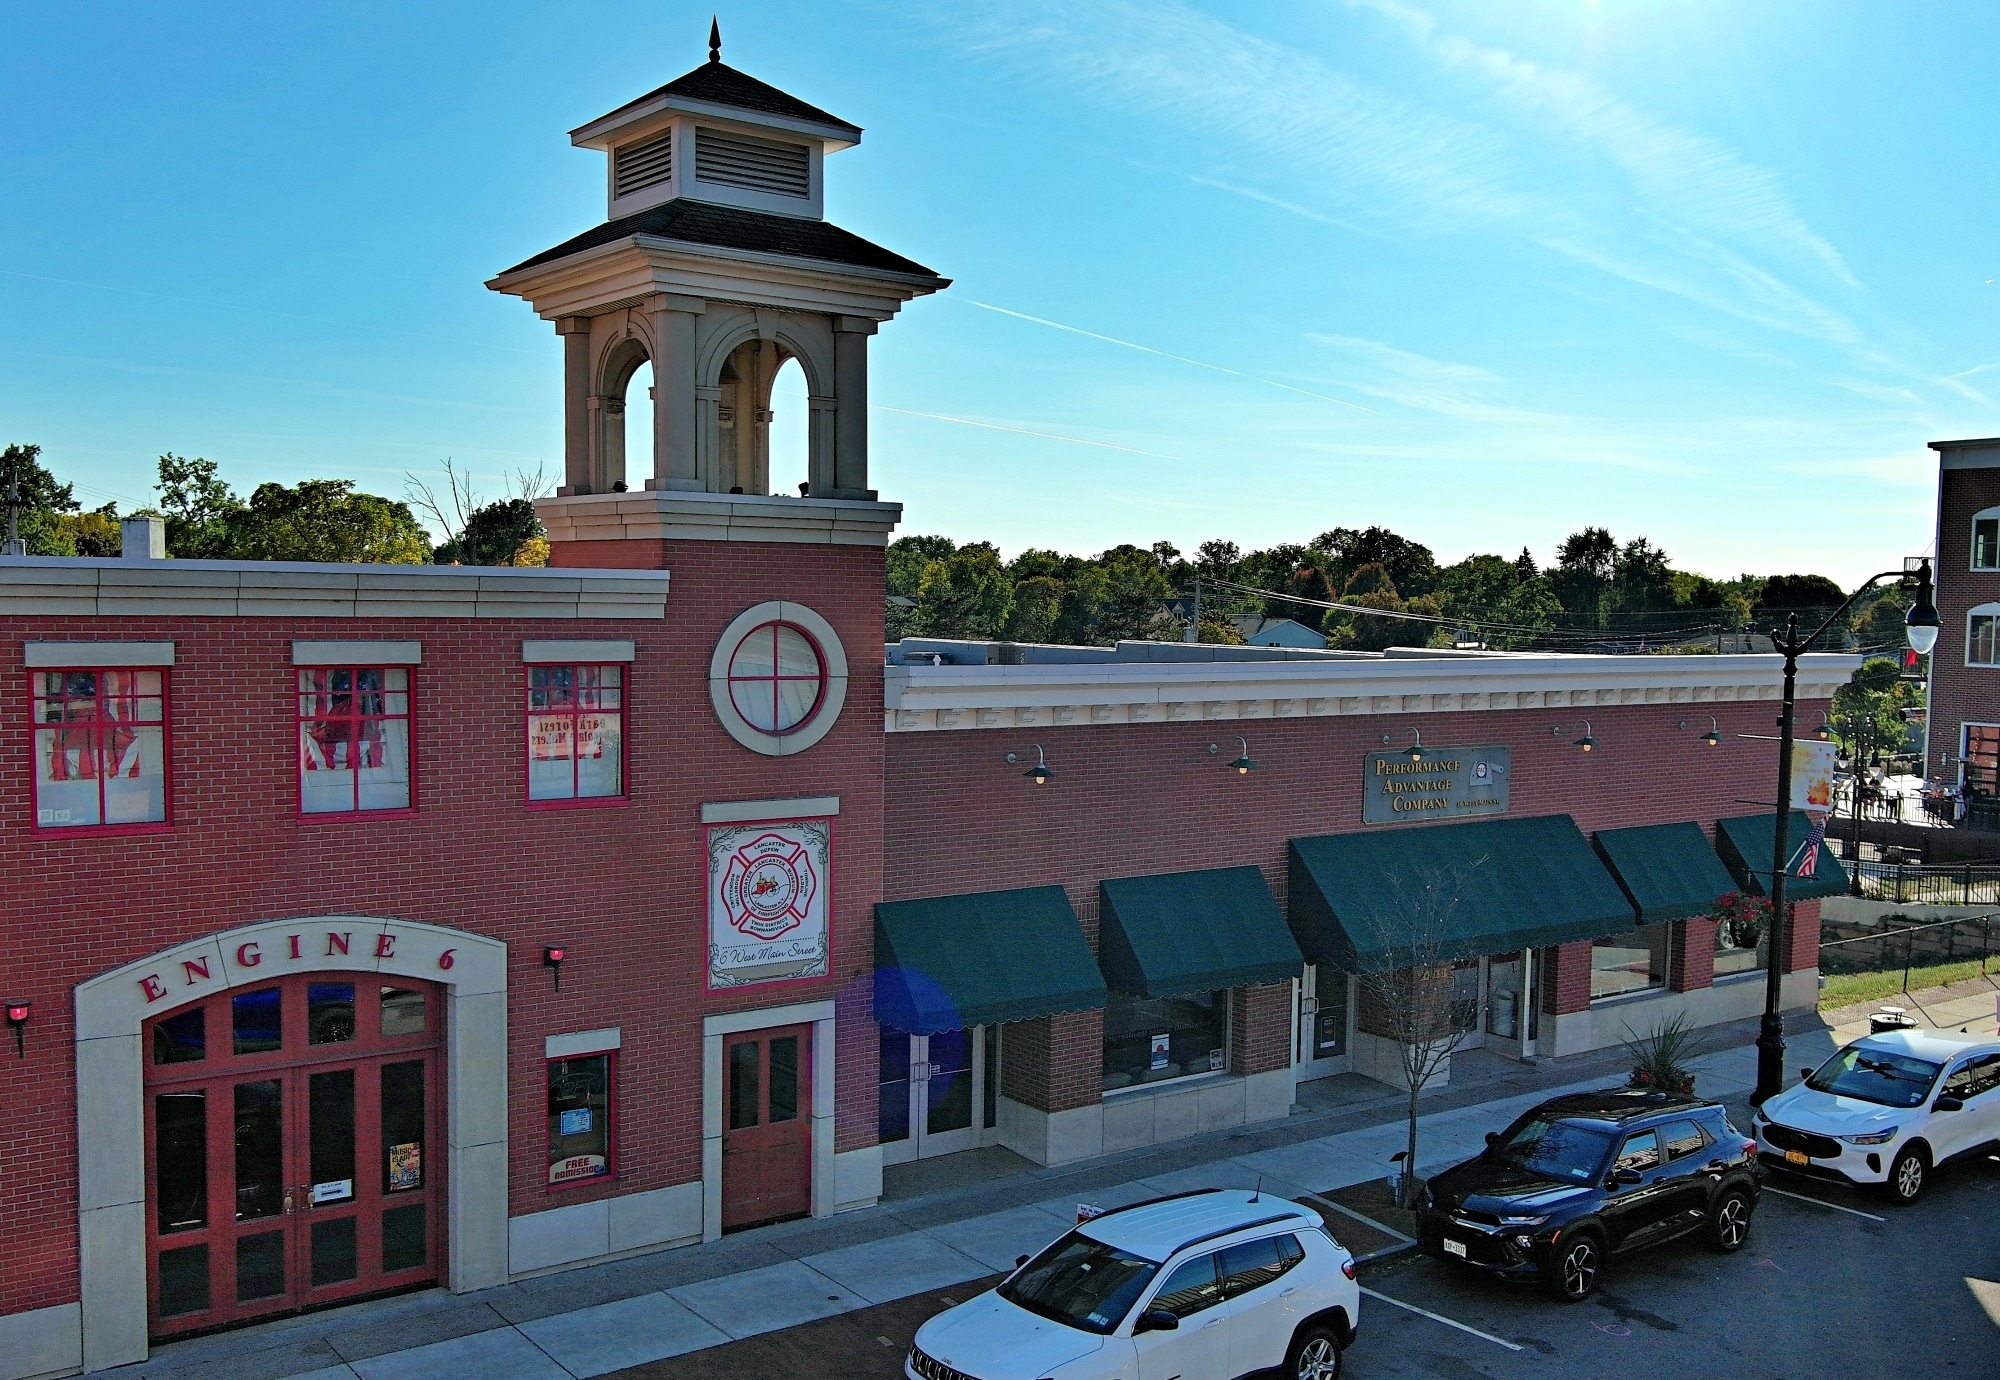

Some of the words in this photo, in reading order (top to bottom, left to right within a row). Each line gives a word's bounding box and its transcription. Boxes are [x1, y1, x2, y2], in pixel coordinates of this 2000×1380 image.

[1375, 759, 1461, 776] PERFORMANCE
[1381, 777, 1452, 794] ADVANTAGE
[1392, 795, 1449, 812] COMPANY
[753, 841, 786, 850] LANCASTER
[743, 870, 753, 898] GREATER
[754, 858, 786, 869] LANCASTER
[787, 868, 796, 894] MUSEUM
[719, 950, 729, 964] 6
[730, 948, 757, 963] West
[758, 946, 786, 960] Main
[788, 942, 817, 957] Street
[137, 932, 397, 1003] ENGINE
[439, 948, 457, 970] 6
[392, 1147, 411, 1157] MUSIC
[565, 1157, 590, 1170] FREE
